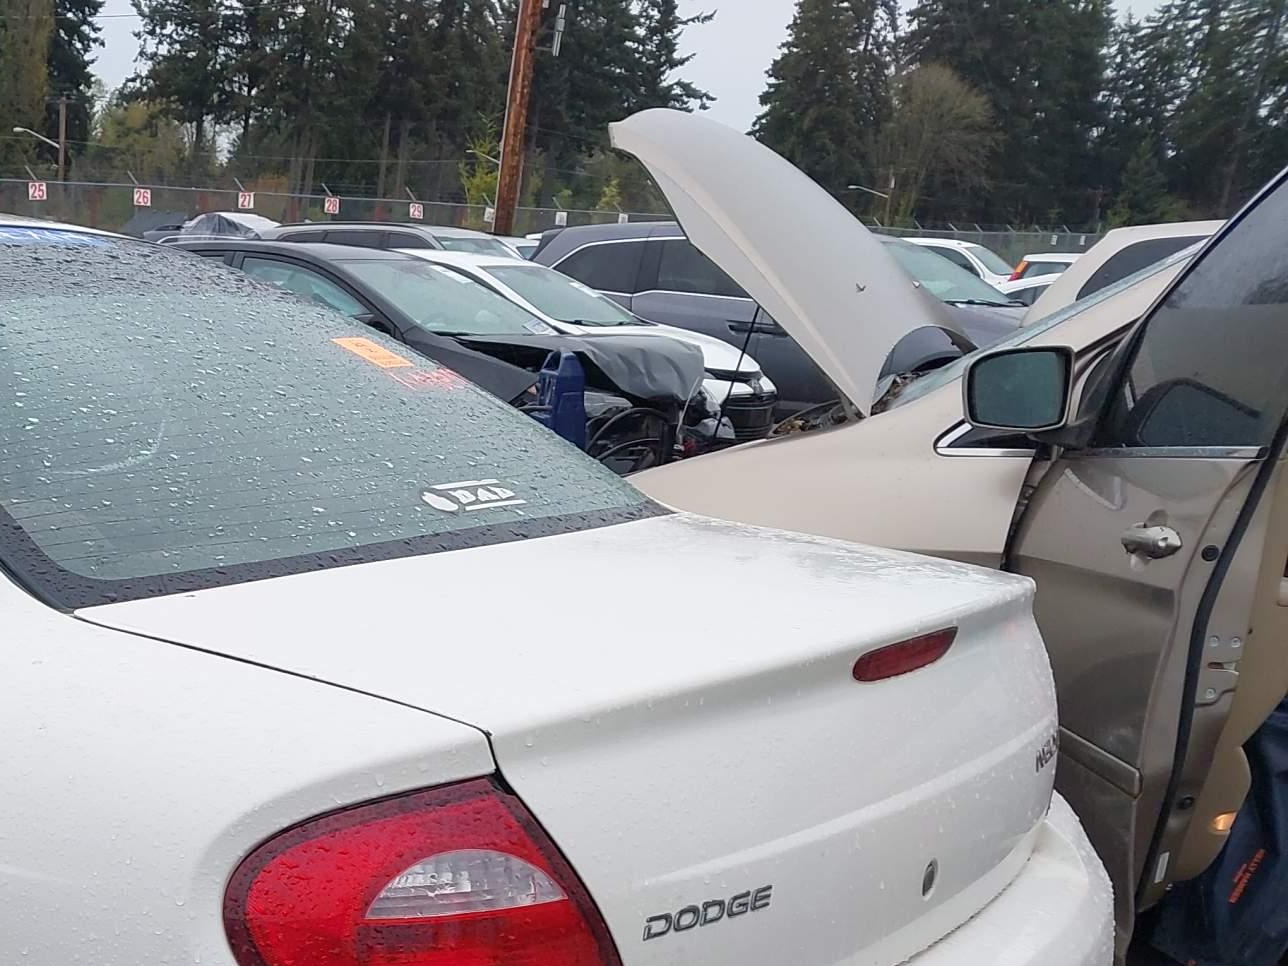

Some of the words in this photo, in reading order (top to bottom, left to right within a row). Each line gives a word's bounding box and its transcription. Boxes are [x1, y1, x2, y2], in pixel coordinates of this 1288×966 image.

[30, 182, 46, 200] 25
[135, 189, 150, 205] 26
[239, 192, 253, 208] 27
[325, 199, 339, 213] 28
[410, 203, 423, 218] 29
[642, 884, 774, 942] DODGE
